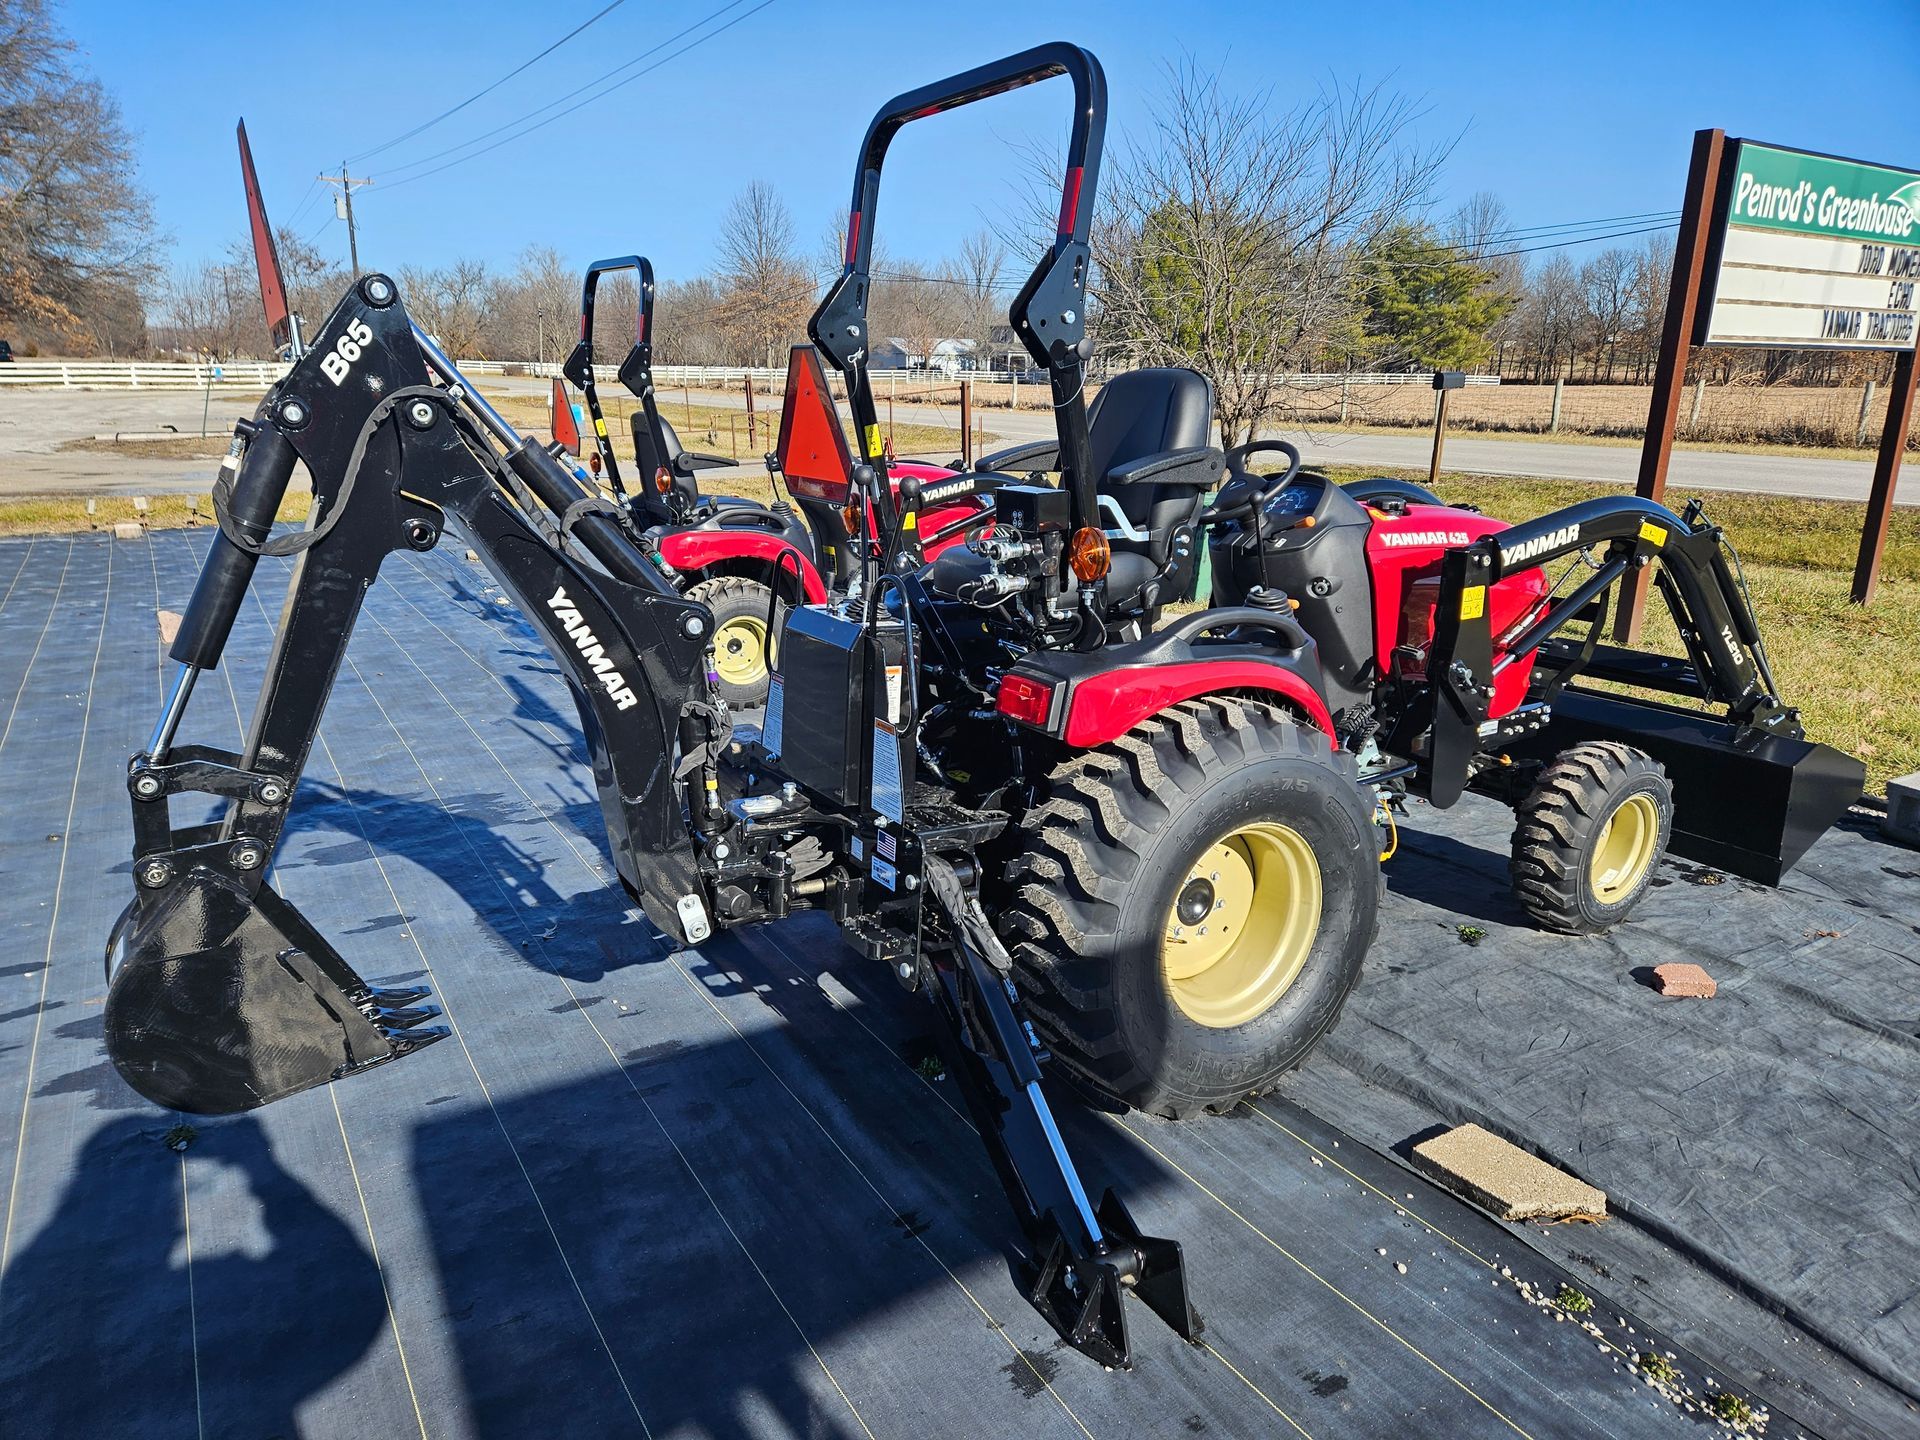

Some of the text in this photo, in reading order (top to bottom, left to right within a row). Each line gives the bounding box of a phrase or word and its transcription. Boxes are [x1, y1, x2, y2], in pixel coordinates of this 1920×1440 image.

[1735, 172, 1915, 238] Penrod's Greenhouse
[1887, 281, 1914, 309] ECHO
[1821, 310, 1913, 341] YANMAR TRACTORS
[320, 317, 373, 387] B65
[922, 478, 975, 502] YANMAR
[1379, 531, 1469, 547] YANMAR 425
[1501, 523, 1580, 567] YANMAR
[546, 586, 637, 711] YANMAR
[1721, 624, 1744, 666] YL210
